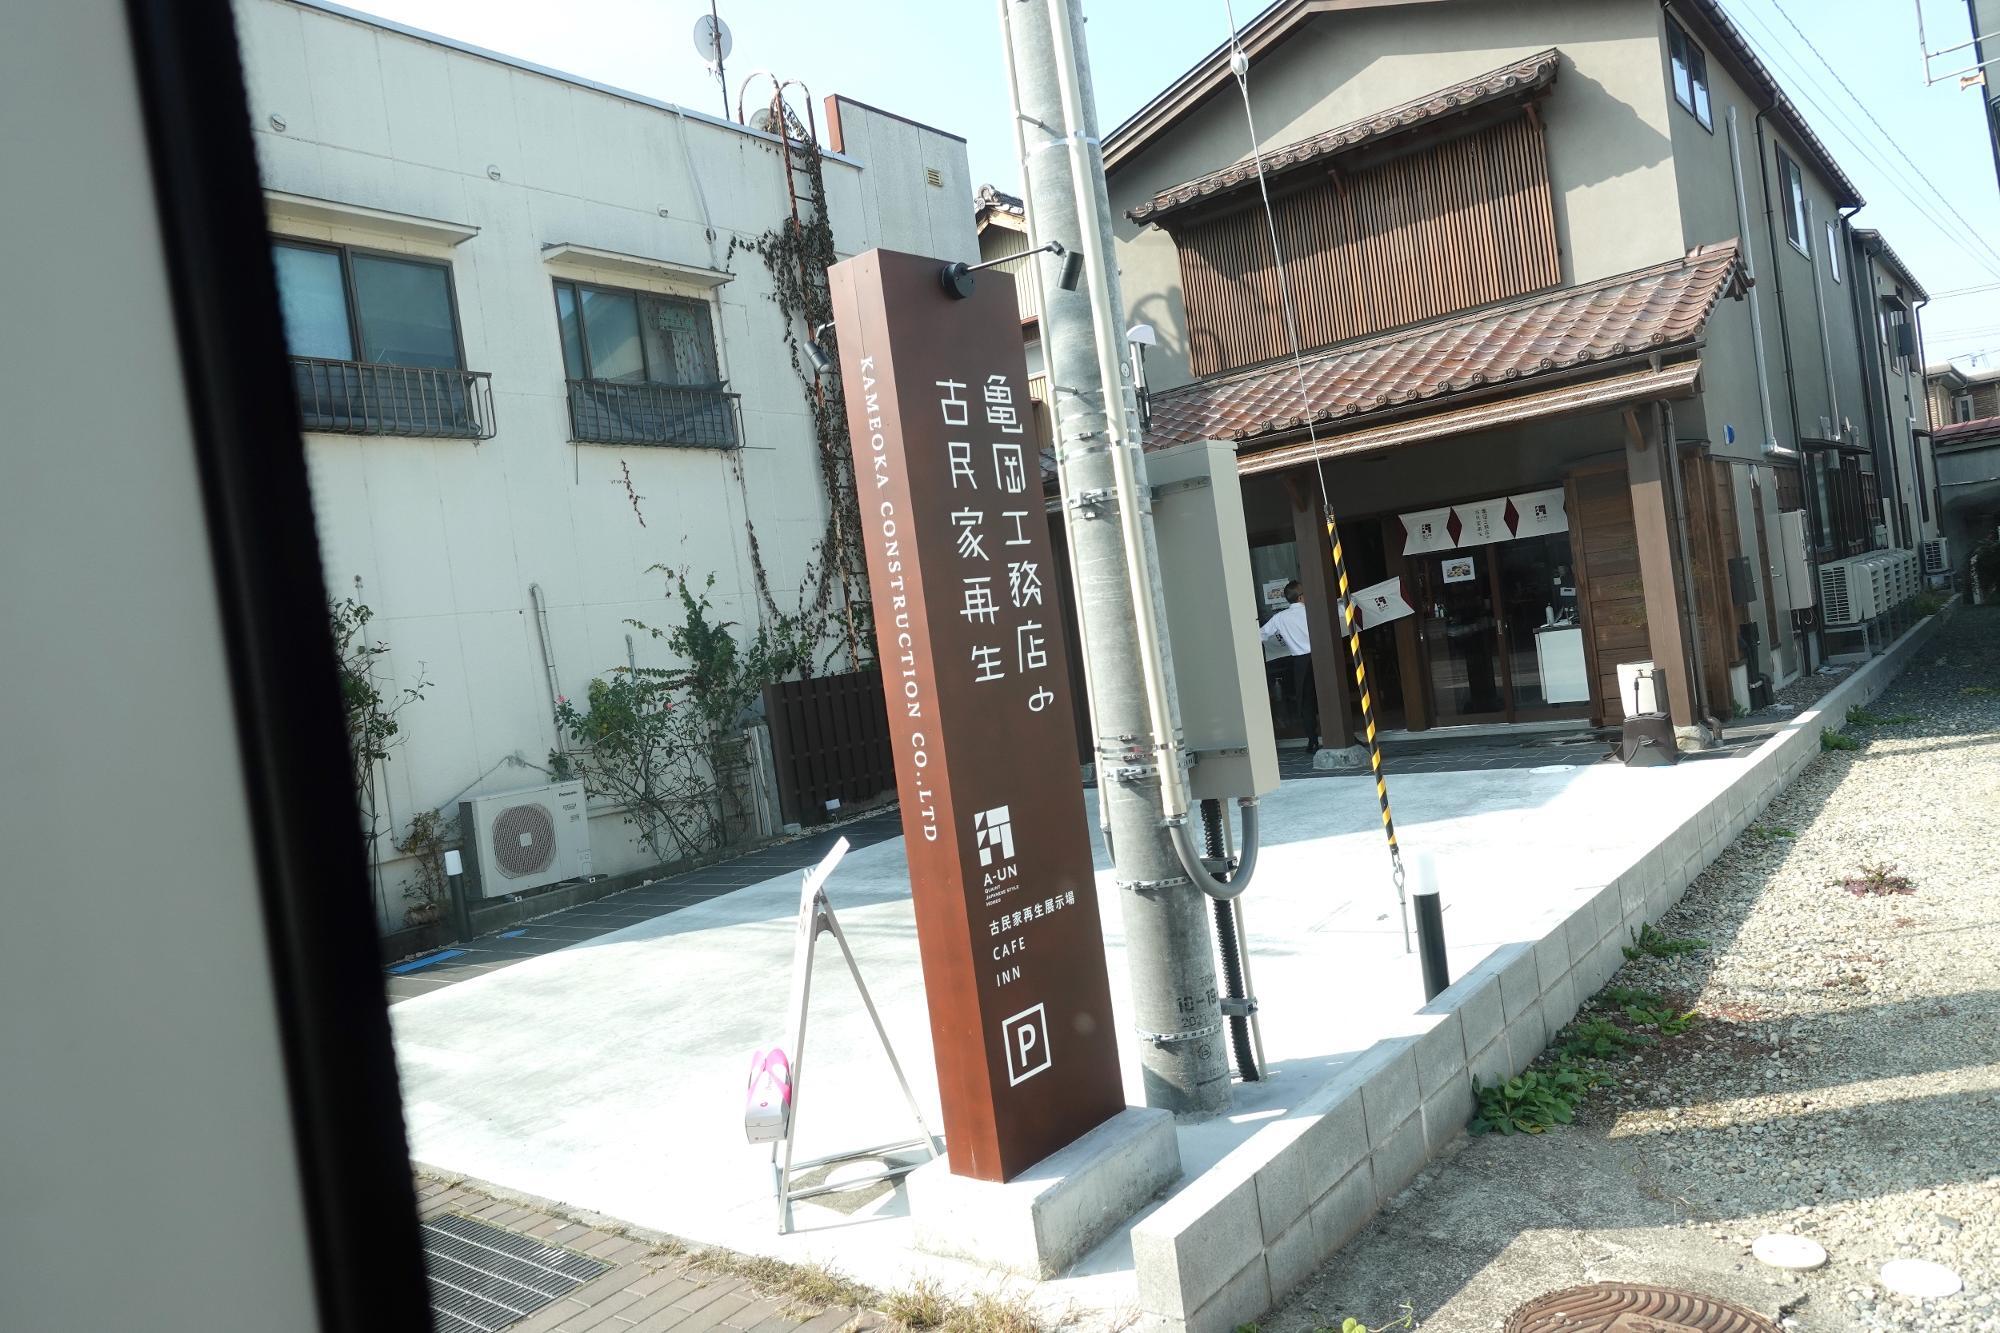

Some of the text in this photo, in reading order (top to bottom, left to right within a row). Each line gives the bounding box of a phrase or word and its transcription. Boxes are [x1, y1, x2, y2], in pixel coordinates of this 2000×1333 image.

[936, 378, 1005, 683] 古民家再生
[984, 375, 1054, 712] 亀岡工務店の
[860, 356, 937, 841] KAMEOKA CONSTRUCTION CO.,LTD
[984, 864, 1018, 887] A-UN
[989, 891, 1075, 936] 古民家再生展示場
[993, 937, 1026, 961] CAFE
[996, 966, 1021, 987] INN
[1018, 1024, 1036, 1067] P
